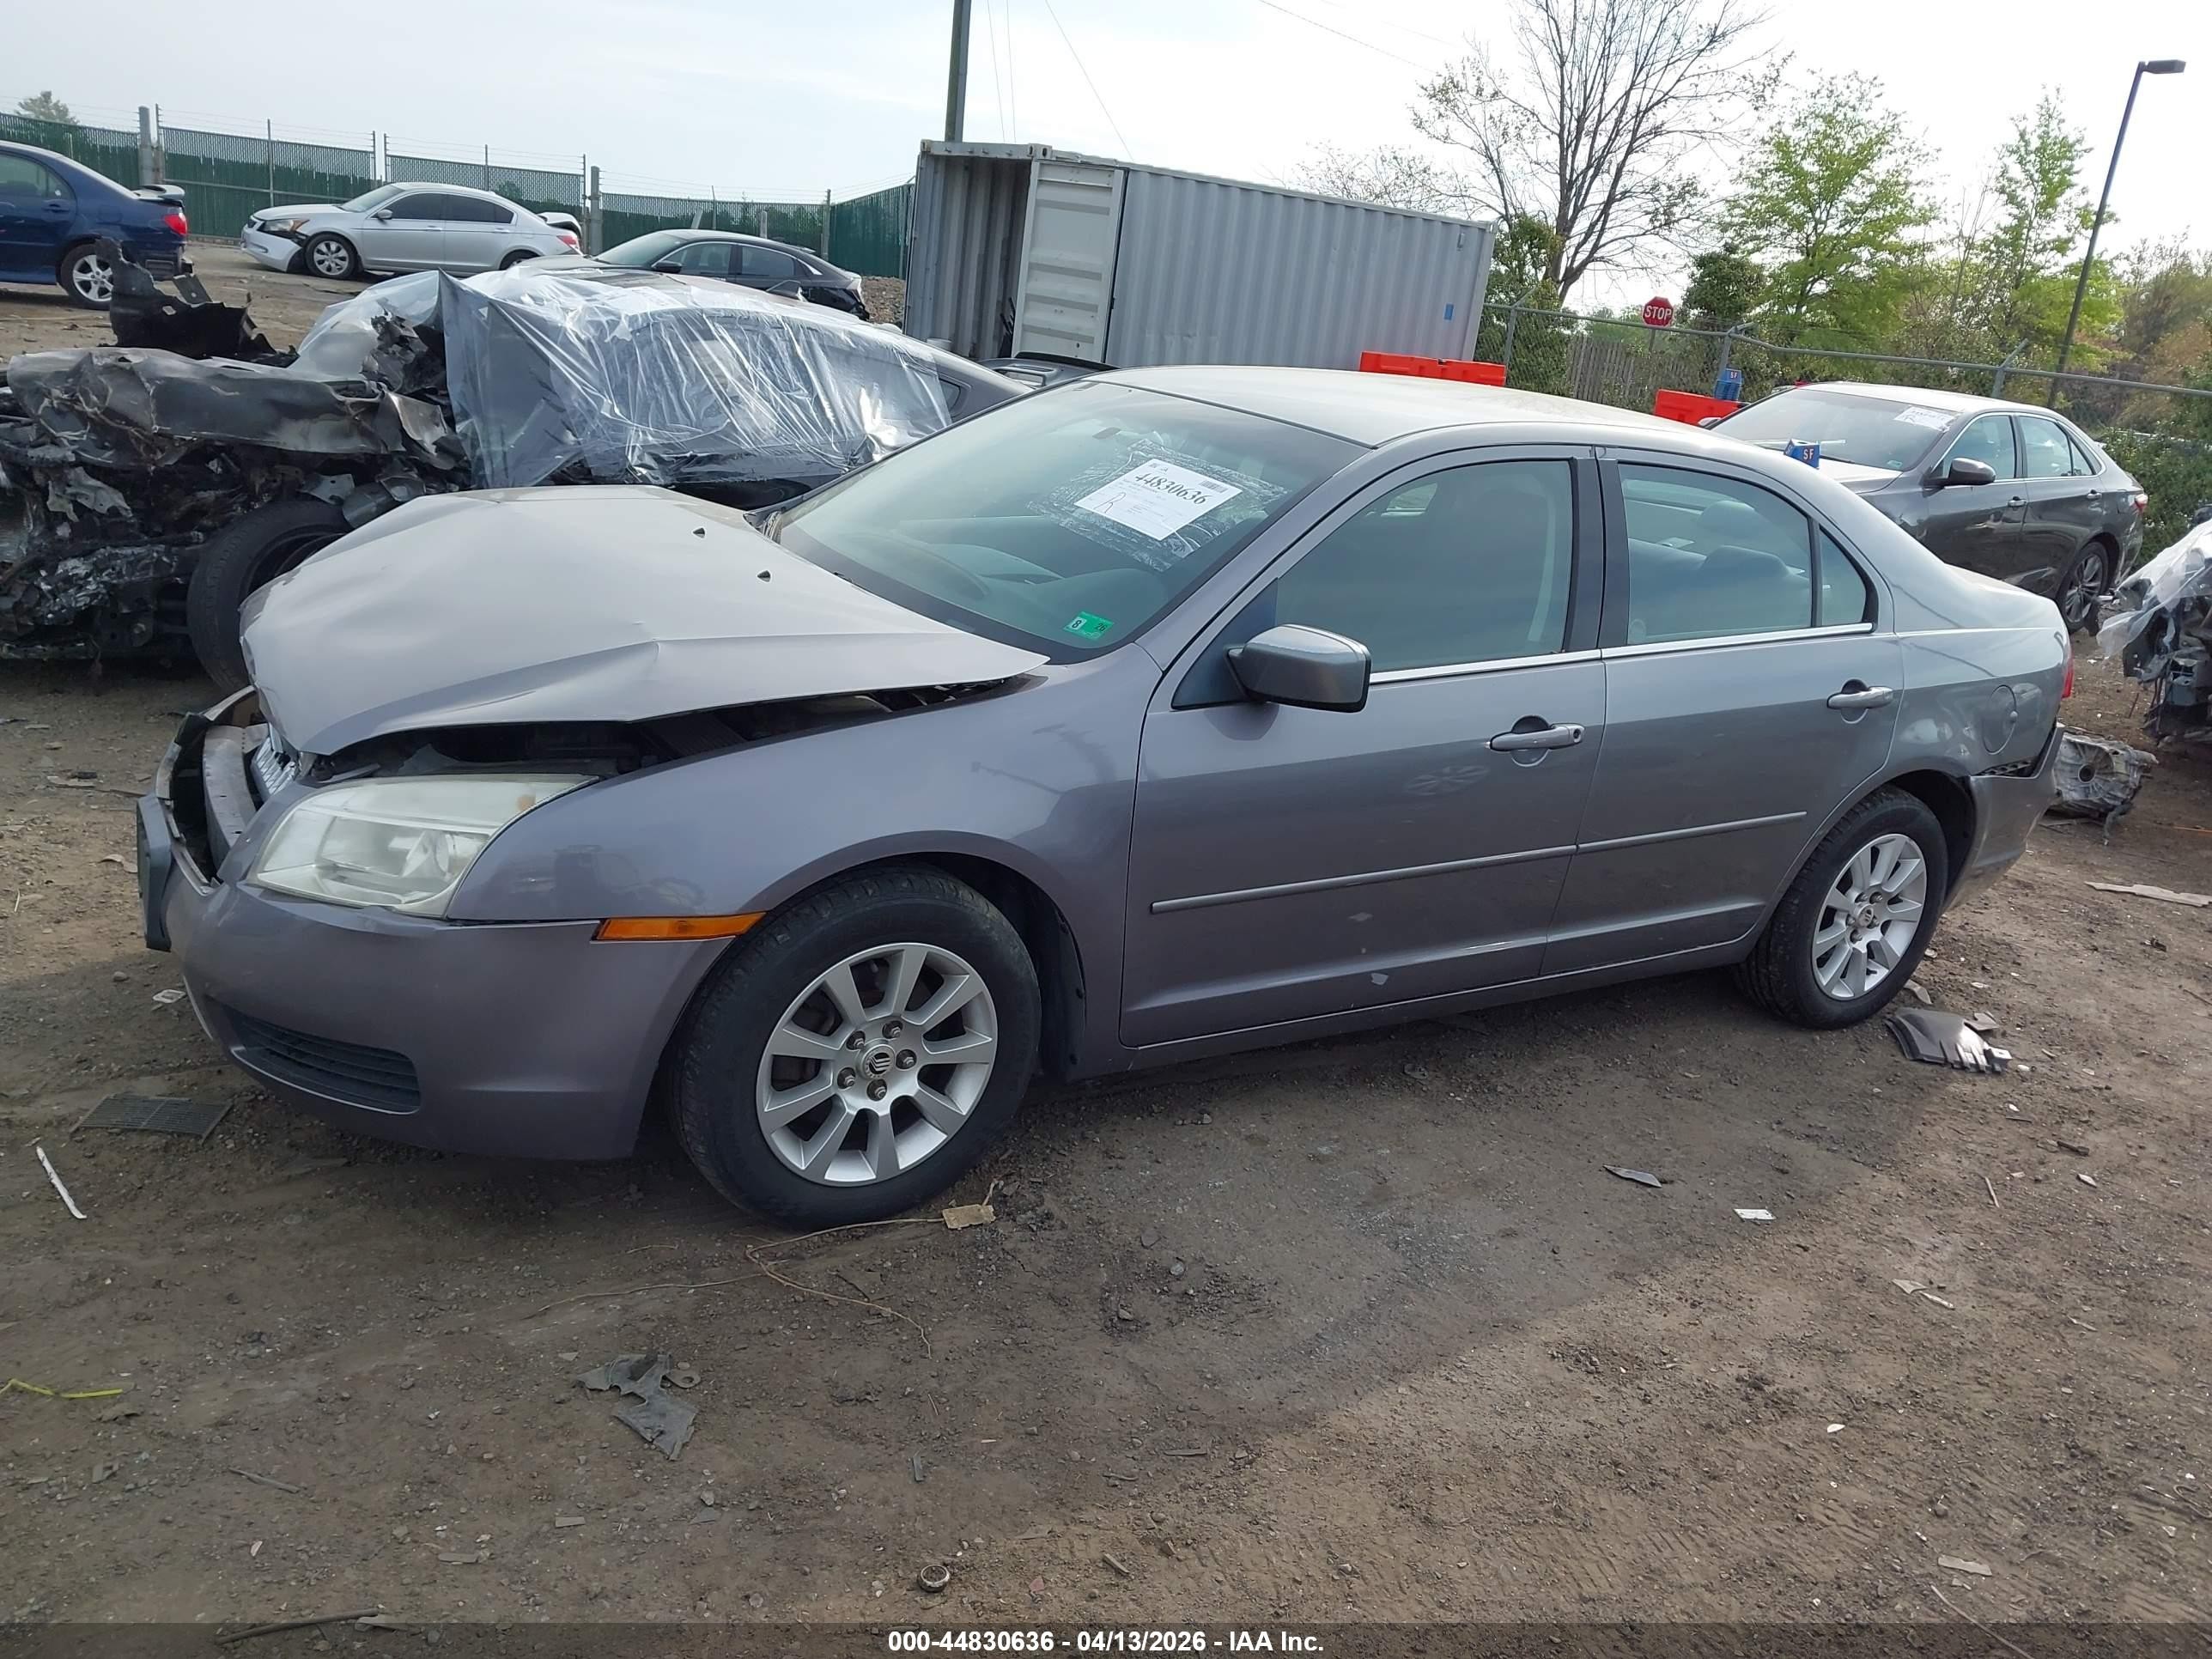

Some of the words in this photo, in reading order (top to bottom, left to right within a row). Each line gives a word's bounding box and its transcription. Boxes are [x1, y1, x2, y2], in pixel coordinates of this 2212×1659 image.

[1644, 305, 1672, 321] STOP
[1803, 447, 1814, 461] SF
[1135, 473, 1212, 505] 44830636
[1071, 619, 1082, 629] 8
